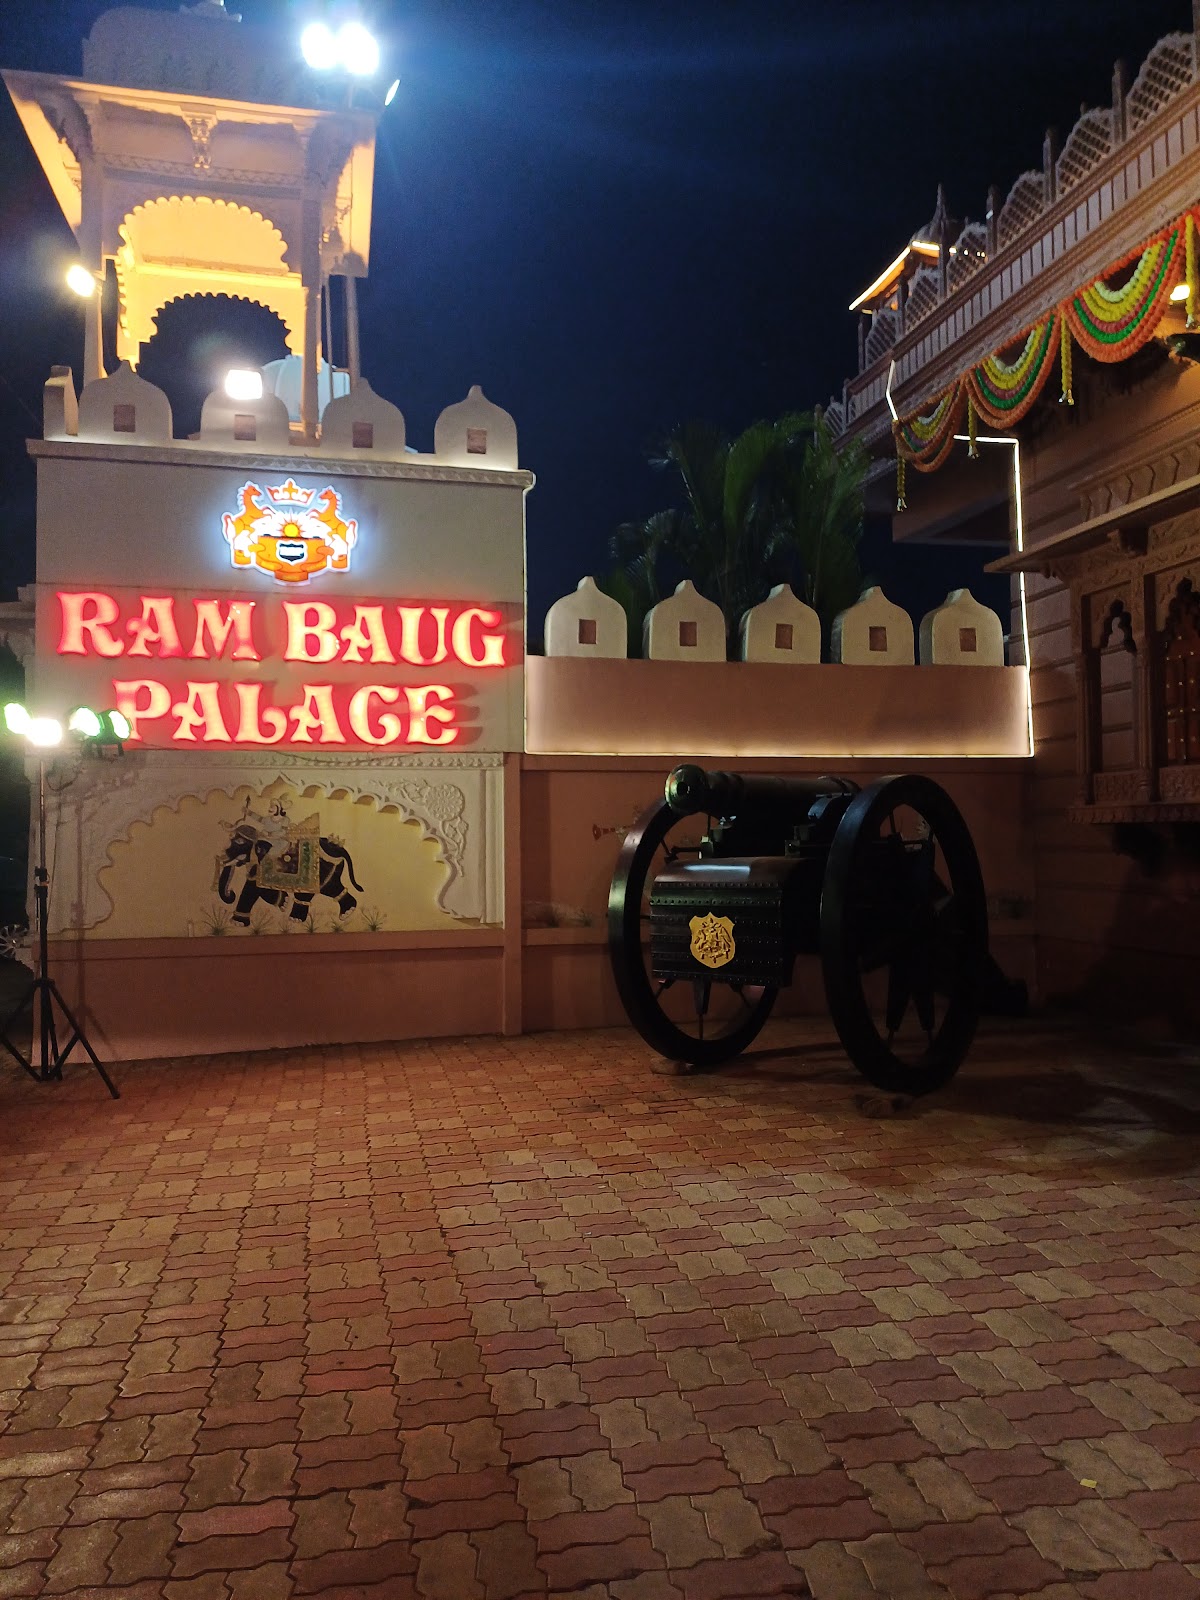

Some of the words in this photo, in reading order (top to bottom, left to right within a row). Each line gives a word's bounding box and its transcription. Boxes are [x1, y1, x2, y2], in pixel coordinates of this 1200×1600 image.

[57, 592, 261, 660] RAM
[282, 601, 506, 667] BAUG
[112, 678, 460, 746] PALACE
